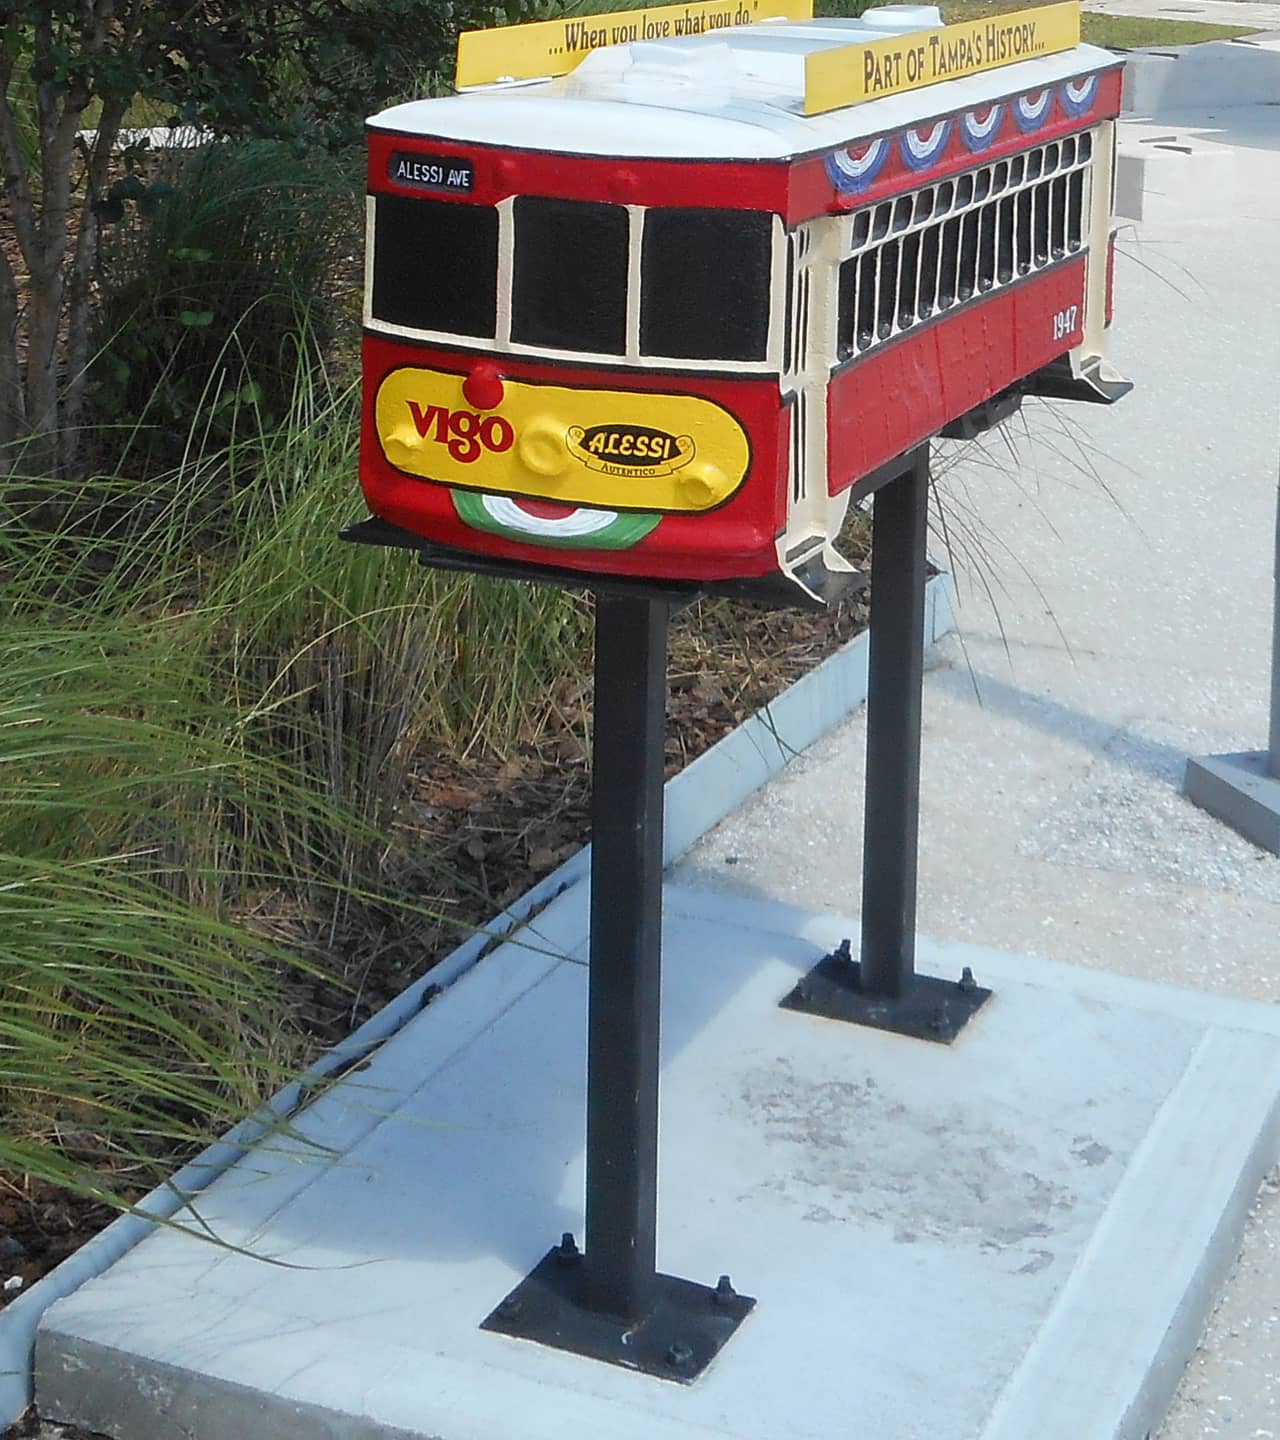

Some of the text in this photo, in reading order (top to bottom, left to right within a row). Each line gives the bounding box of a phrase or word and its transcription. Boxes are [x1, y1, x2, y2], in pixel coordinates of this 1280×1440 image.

[612, 23, 638, 46] you
[641, 14, 671, 41] love
[674, 8, 706, 37] what
[709, 11, 732, 30] you
[863, 49, 903, 94] PART
[906, 46, 925, 83] OF
[928, 29, 983, 77] TAMPA'S
[397, 160, 471, 187] ALESSI AVE
[1052, 305, 1078, 341] 1947
[588, 430, 672, 460] ALESSI
